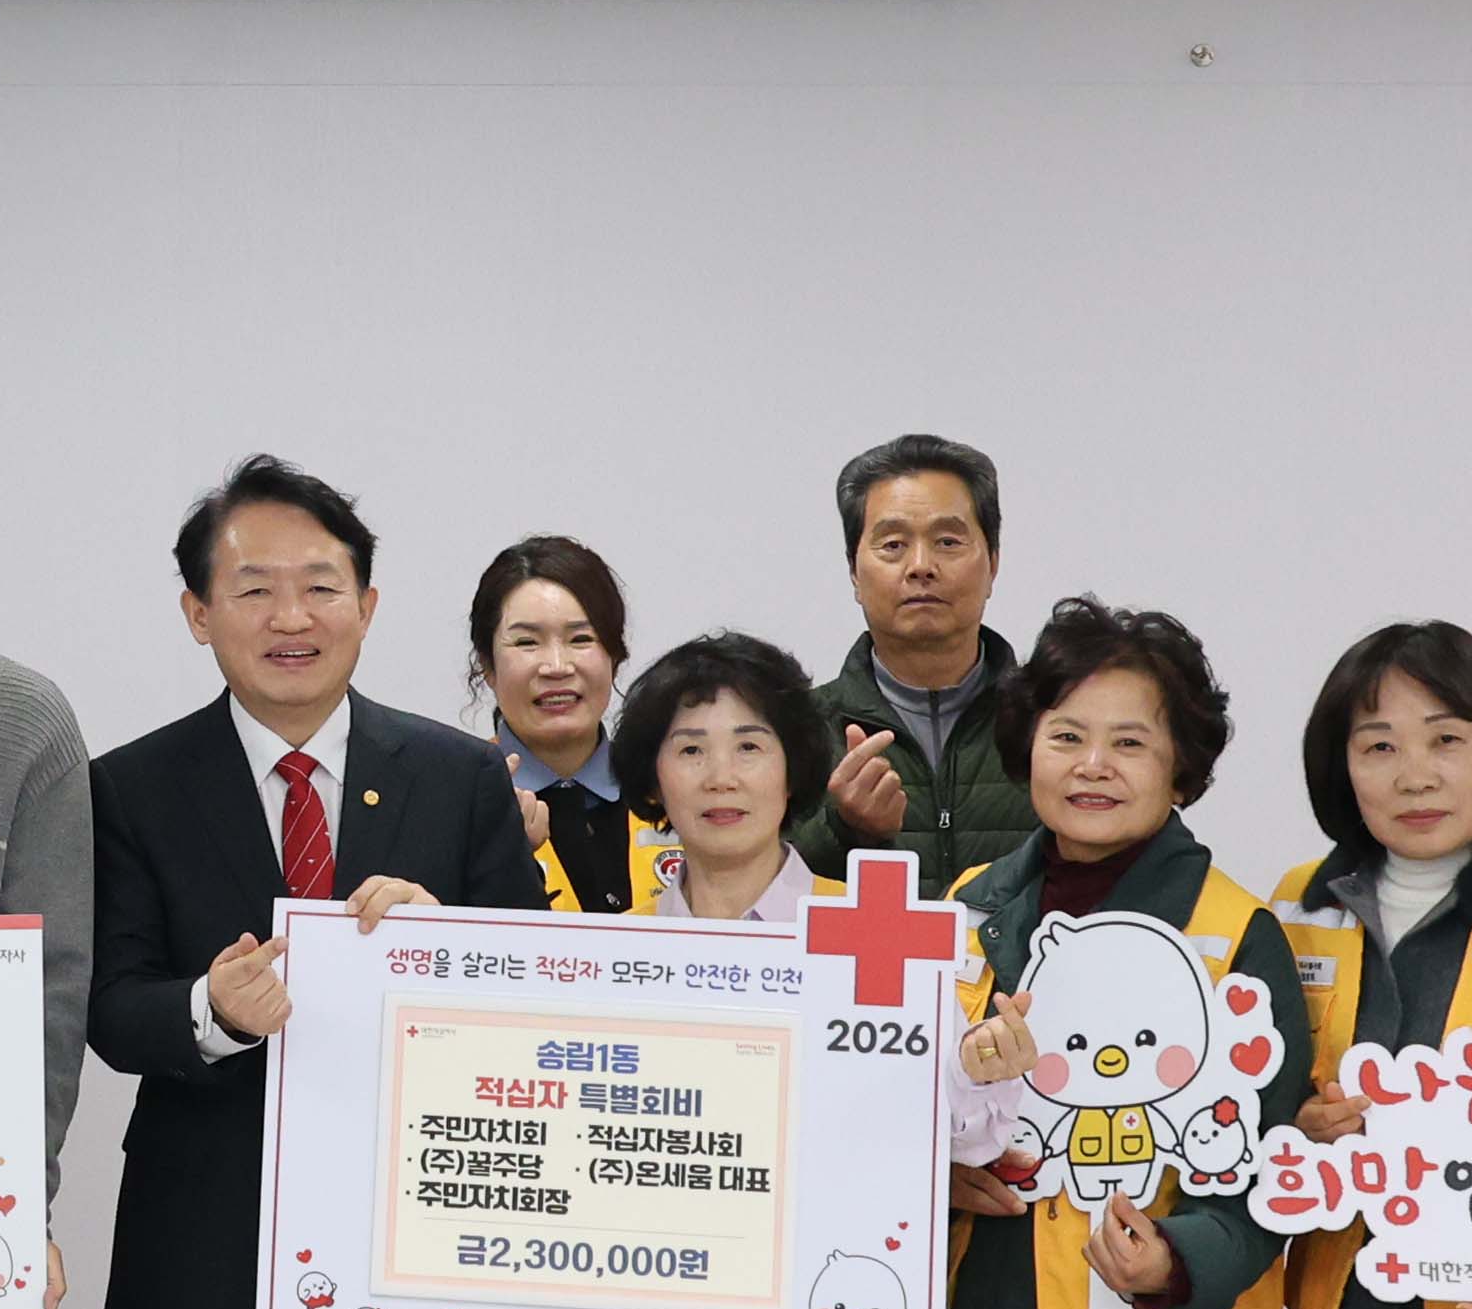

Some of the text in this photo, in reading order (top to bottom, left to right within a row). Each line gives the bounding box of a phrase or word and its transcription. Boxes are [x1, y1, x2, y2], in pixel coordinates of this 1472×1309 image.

[385, 947, 803, 995] 생명을 살리는 적십자 모두가 안전한 인천
[535, 1040, 641, 1075] 송림1동
[826, 1018, 930, 1057] 2026
[474, 1075, 703, 1118] 적십자 특별회비
[419, 1114, 743, 1161] 주민자치회 적십자봉사회
[418, 1147, 771, 1193] (주)꿀주당 (주)온세움 대표
[416, 1180, 572, 1216] 주민자치회장
[456, 1234, 709, 1281] 금2,300,000원
